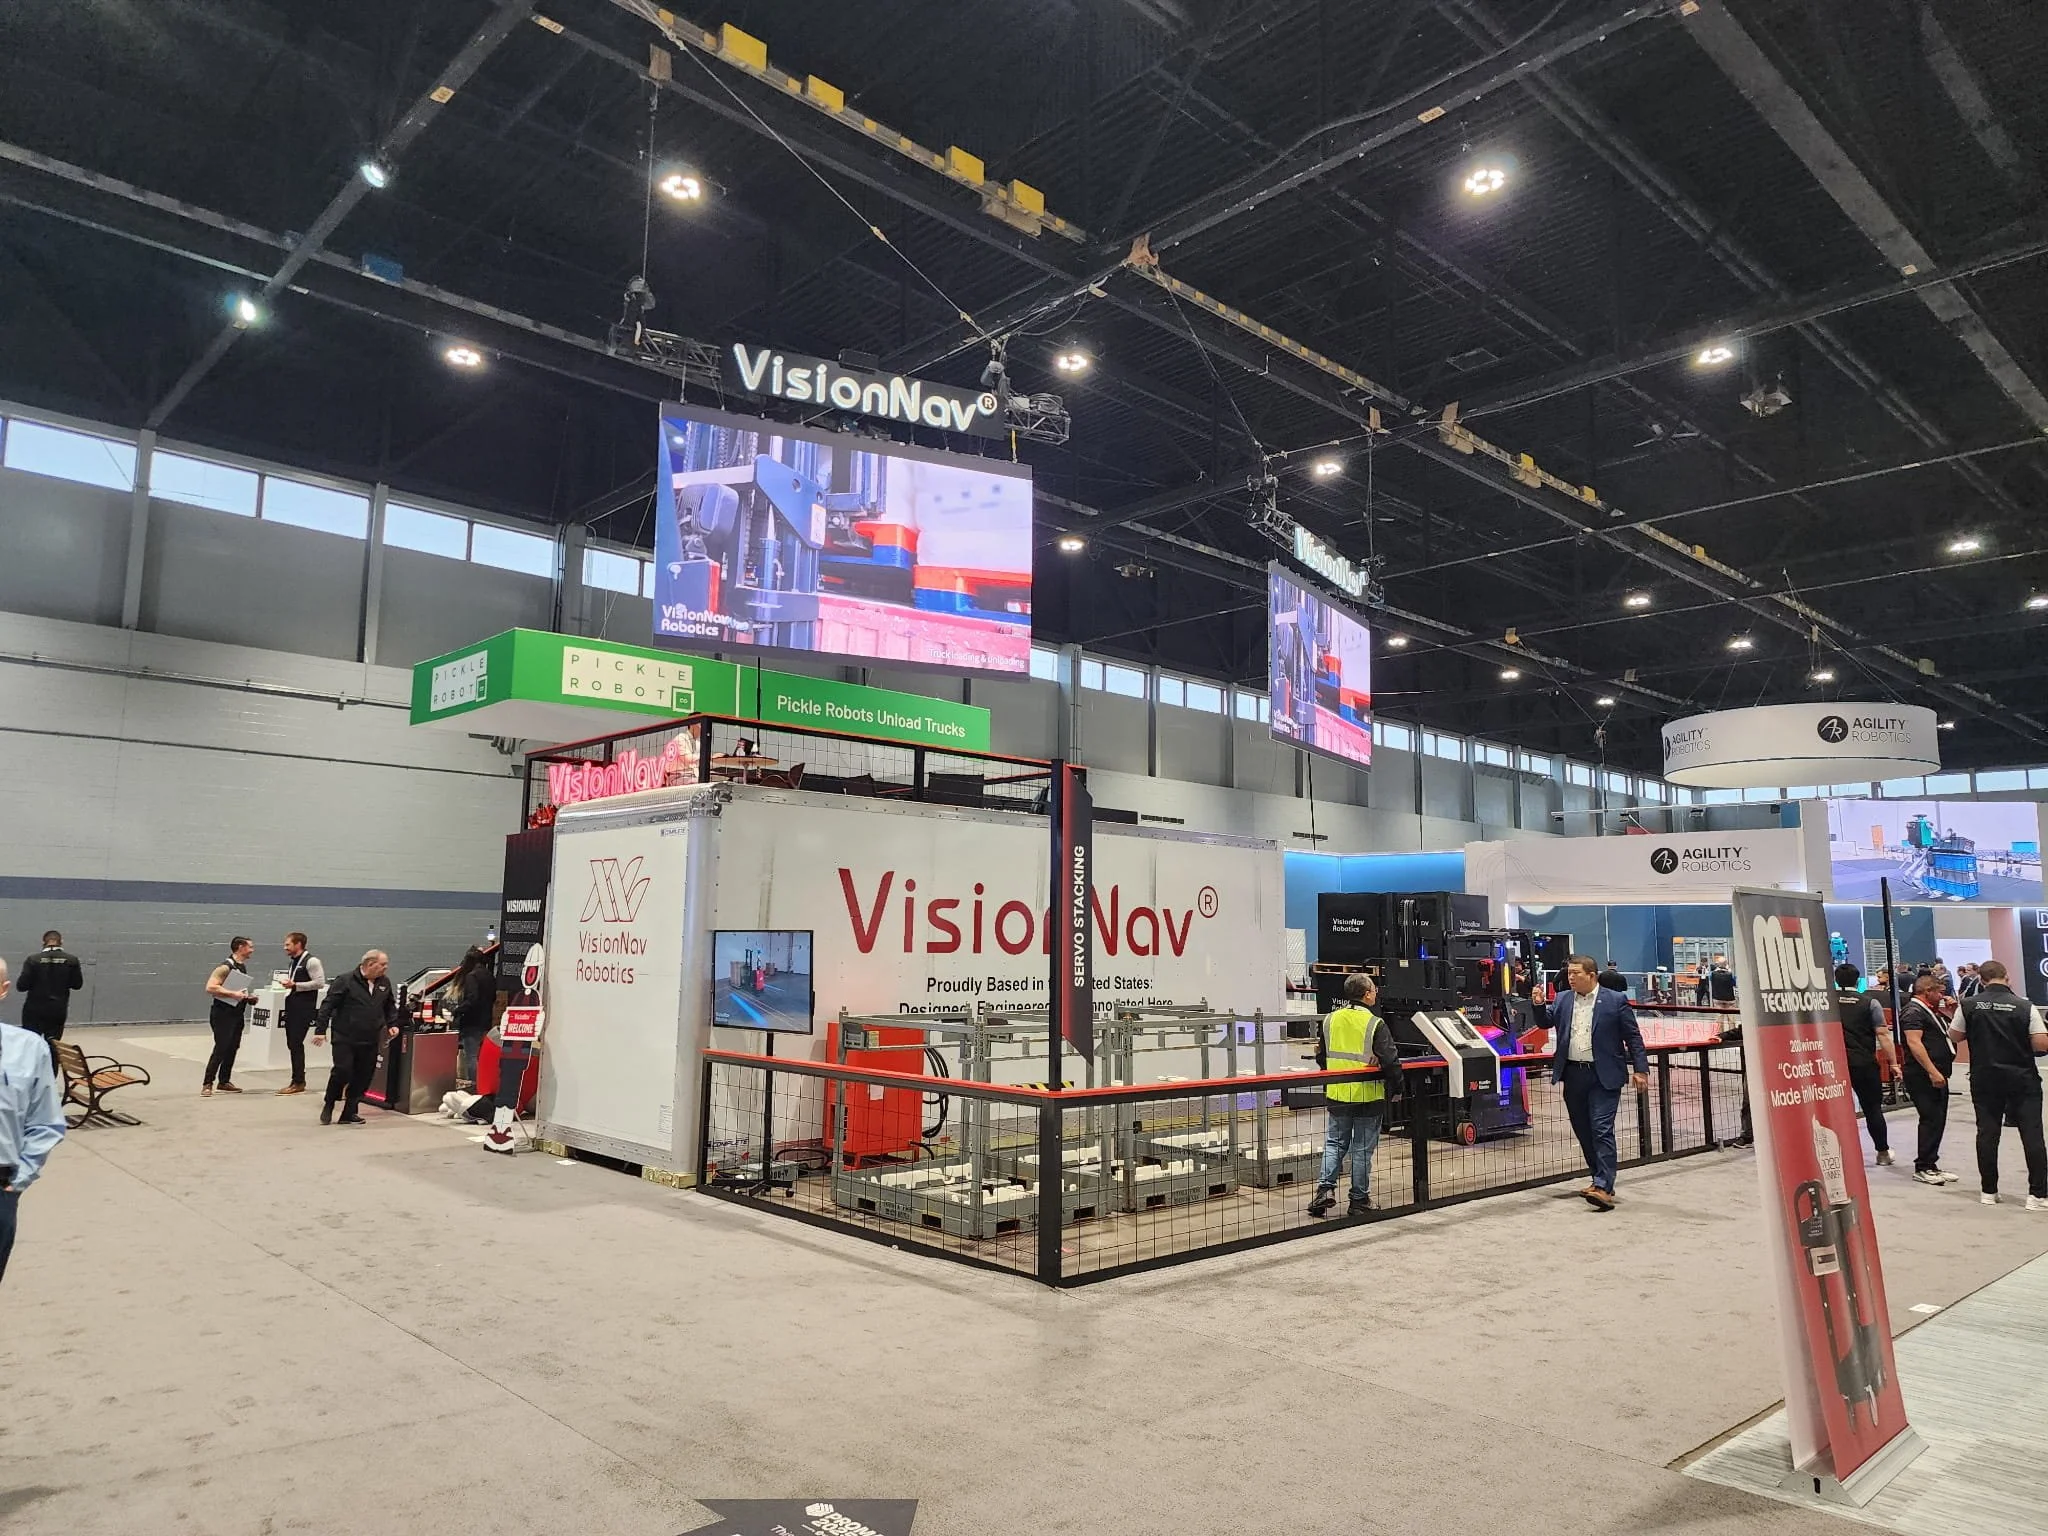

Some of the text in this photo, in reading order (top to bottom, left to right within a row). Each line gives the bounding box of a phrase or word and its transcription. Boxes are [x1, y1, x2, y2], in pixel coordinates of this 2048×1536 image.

[661, 618, 719, 636] Robotics
[571, 654, 686, 681] PICKLE
[929, 648, 950, 659] Truck
[951, 651, 981, 664] loading
[988, 655, 1025, 669] unloading
[435, 658, 484, 683] PICKLE
[434, 684, 473, 705] ROBOT
[570, 677, 664, 700] ROBOT
[777, 694, 966, 738] Pickle Robots Unload Trucks
[1851, 730, 1912, 743] ROBOTICS
[1671, 739, 1711, 757] ROBOTICS
[1681, 860, 1752, 872] ROBOTICS
[506, 899, 541, 913] VISIONNAV
[1074, 845, 1085, 987] SERVO STACKING
[1332, 918, 1365, 926] VisionNav
[579, 930, 647, 956] VisionNav
[576, 958, 634, 984] Robotics
[927, 977, 982, 996] Proudly
[986, 976, 1030, 992] Based
[1032, 976, 1044, 991] in
[1114, 976, 1153, 990] States:
[508, 1022, 535, 1034] WELCOME
[1771, 1088, 1801, 1108] Made
